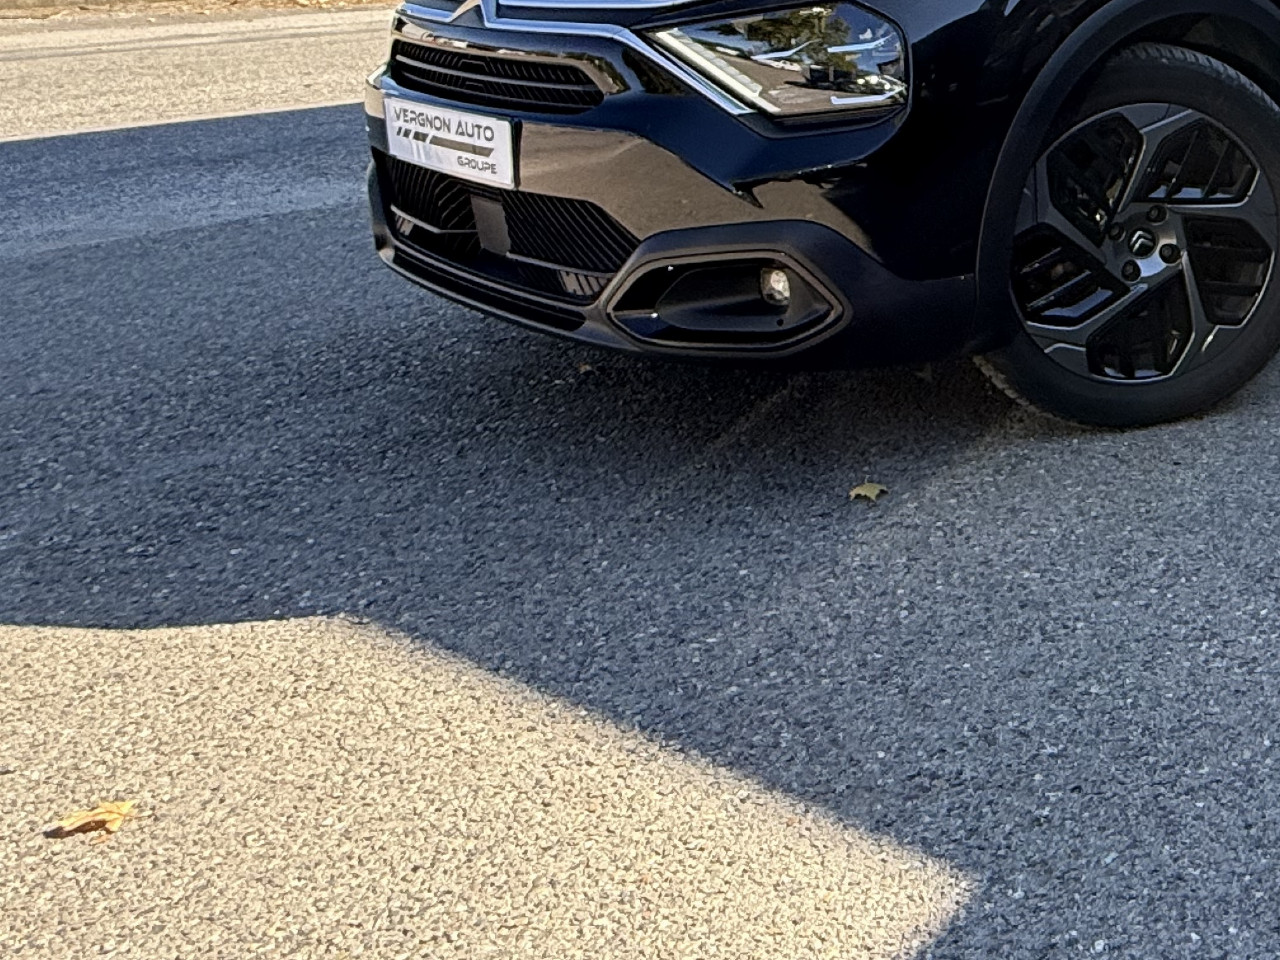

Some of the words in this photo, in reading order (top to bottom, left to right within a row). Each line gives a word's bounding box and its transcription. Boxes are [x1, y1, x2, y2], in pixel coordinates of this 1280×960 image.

[394, 106, 452, 134] VERGNON
[455, 119, 495, 142] AUTO
[457, 155, 498, 175] GROUPE
